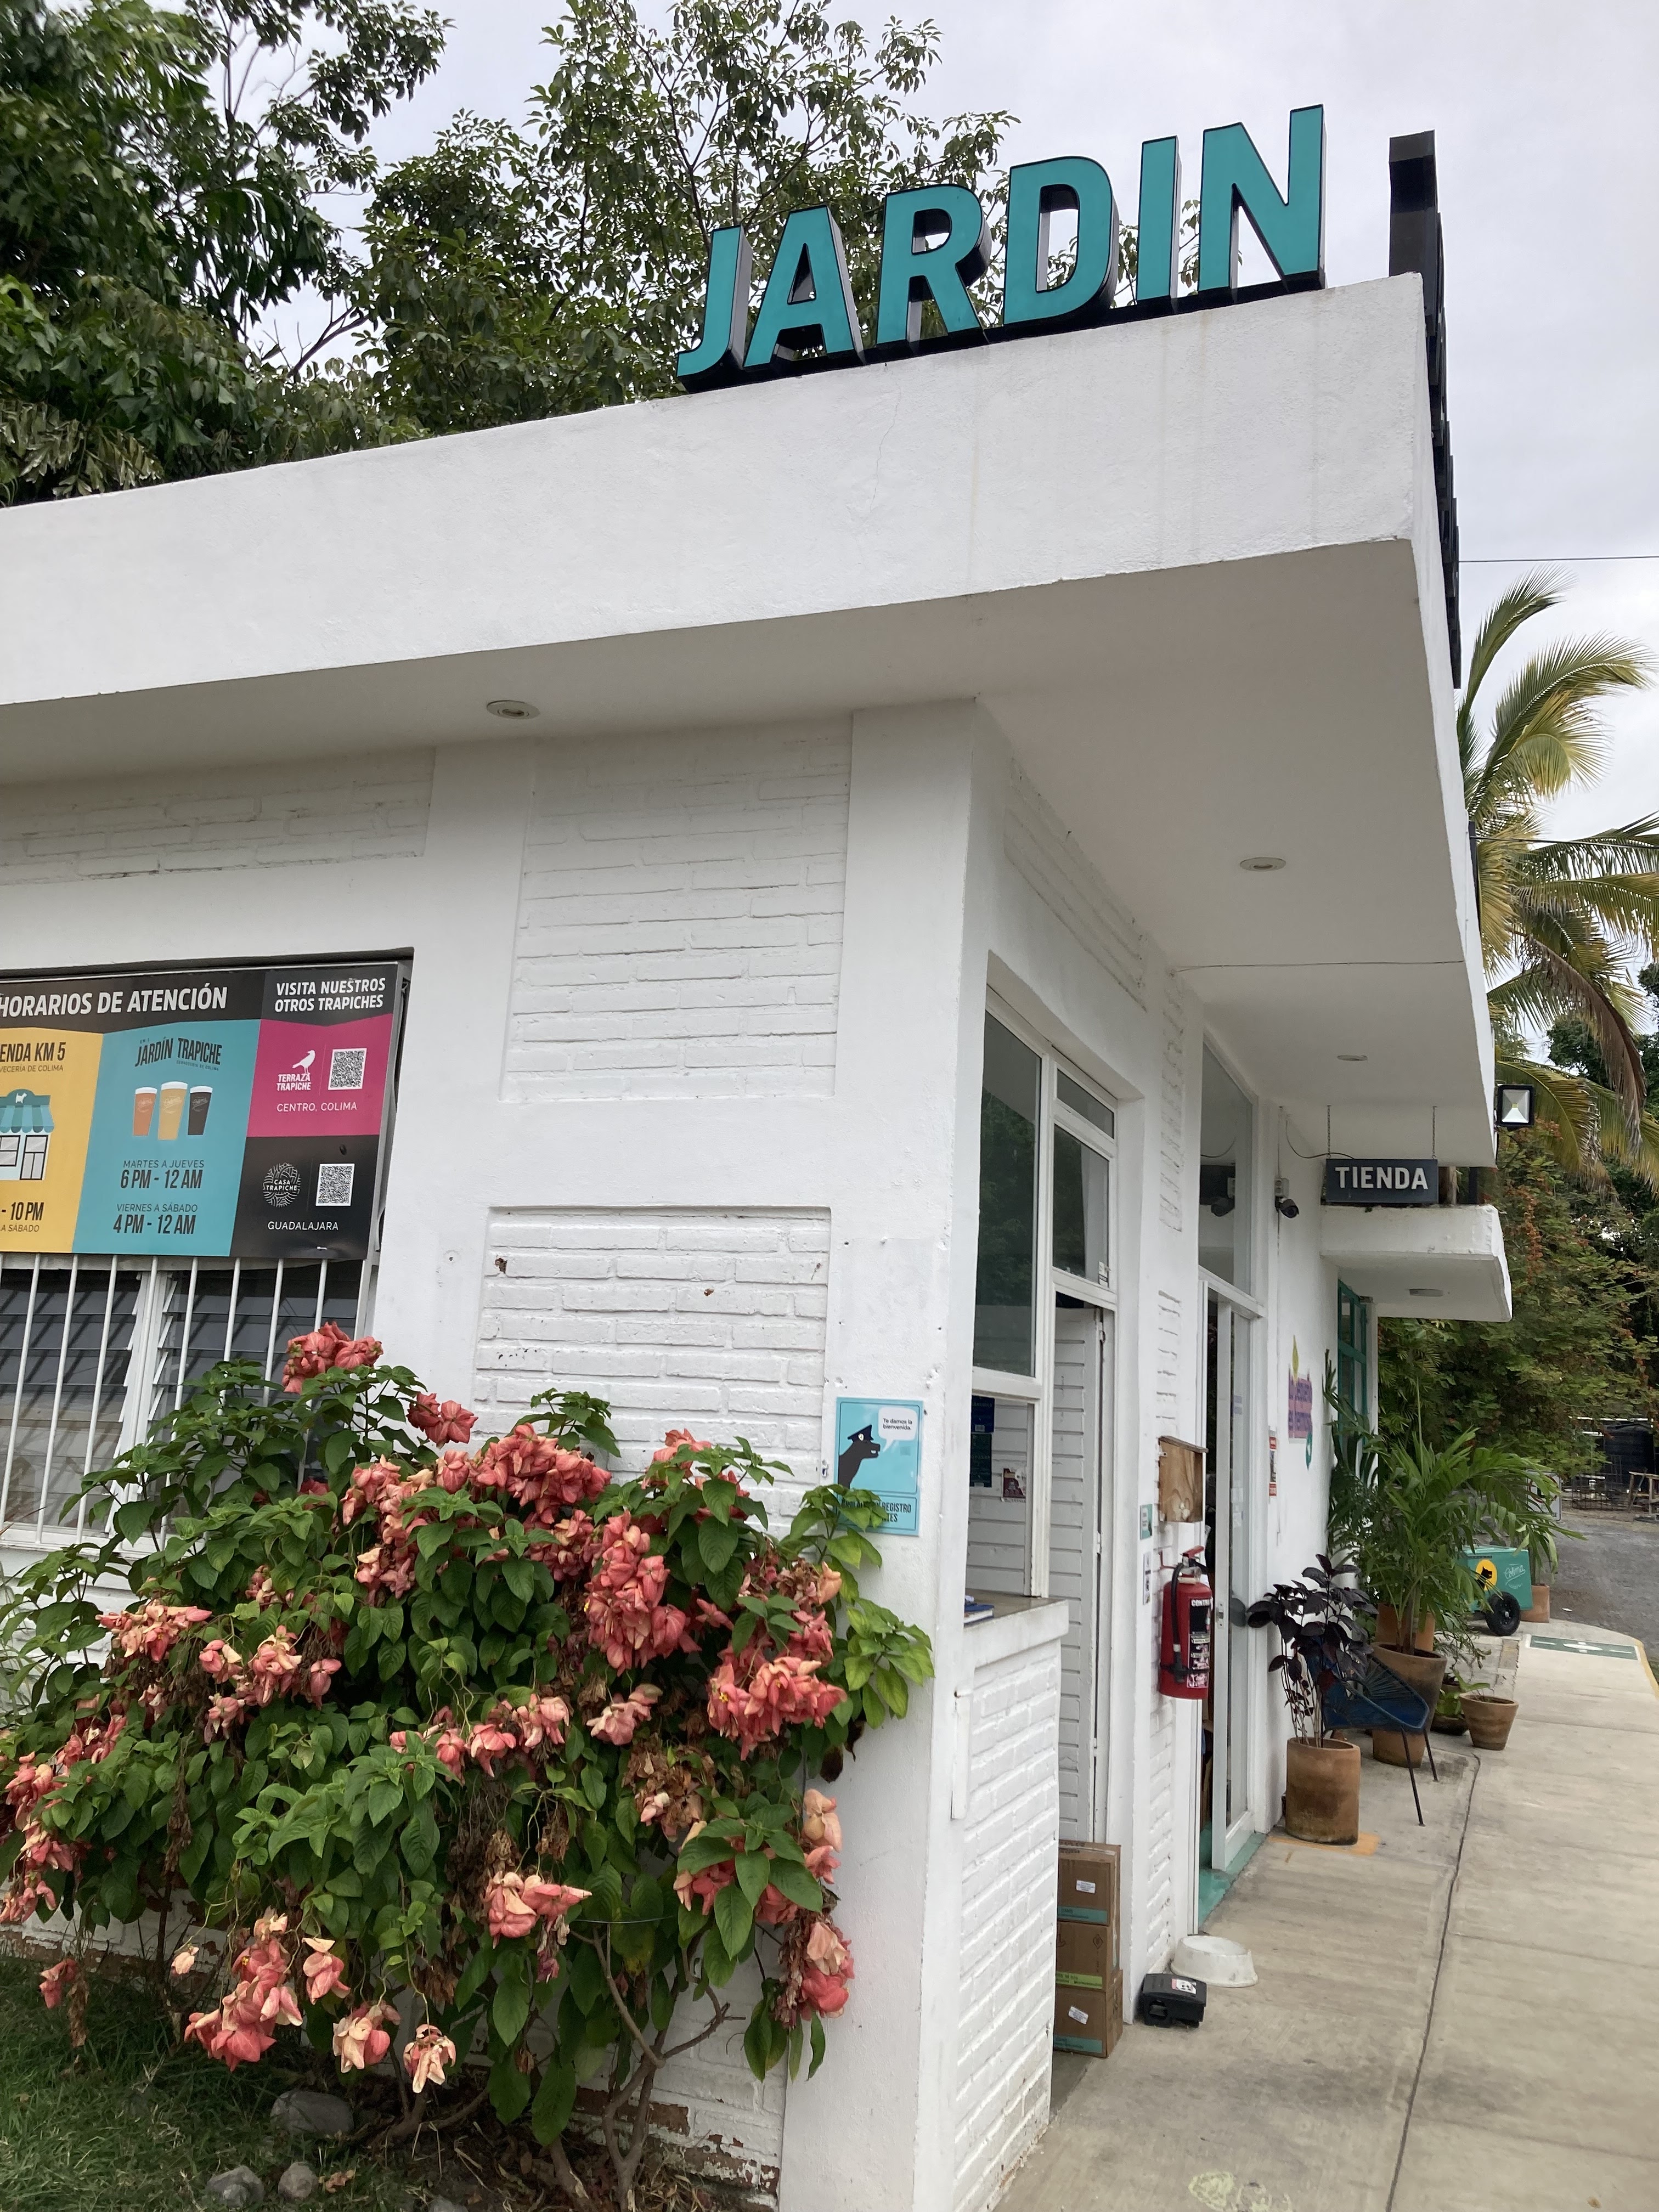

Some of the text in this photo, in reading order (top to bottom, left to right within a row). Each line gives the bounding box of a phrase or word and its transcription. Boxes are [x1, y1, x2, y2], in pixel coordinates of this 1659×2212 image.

[676, 104, 1324, 377] JARDIN
[276, 978, 386, 996] VISITA NUESTROS
[0, 983, 228, 1017] HORARIOS DE ATENCIÓN
[275, 995, 383, 1012] OTROS TRAPICHES
[34, 1042, 55, 1062] KM
[57, 1042, 66, 1061] 5
[134, 1036, 222, 1067] JARDÍN TRAPICHE
[276, 1082, 311, 1091] TRAPICHE
[278, 1073, 311, 1082] TERRAZA
[276, 1102, 357, 1113] CENTRO, COLIMA
[123, 1160, 204, 1168] MARTES A JUEVES
[120, 1169, 129, 1189] 6
[131, 1169, 151, 1189] PM
[165, 1169, 179, 1189] 12
[180, 1169, 203, 1189] AM
[1335, 1166, 1429, 1190] TIENDA
[10, 1201, 24, 1221] 10
[25, 1201, 44, 1221] PM
[117, 1204, 152, 1212] VIERNES
[162, 1202, 198, 1212] SÁBADO
[8, 1223, 40, 1232] SÁBADO
[113, 1214, 122, 1233] 4
[124, 1214, 145, 1234] PM
[157, 1214, 172, 1234] 12
[173, 1215, 196, 1234] AM
[268, 1221, 339, 1231] GUADALAJARA
